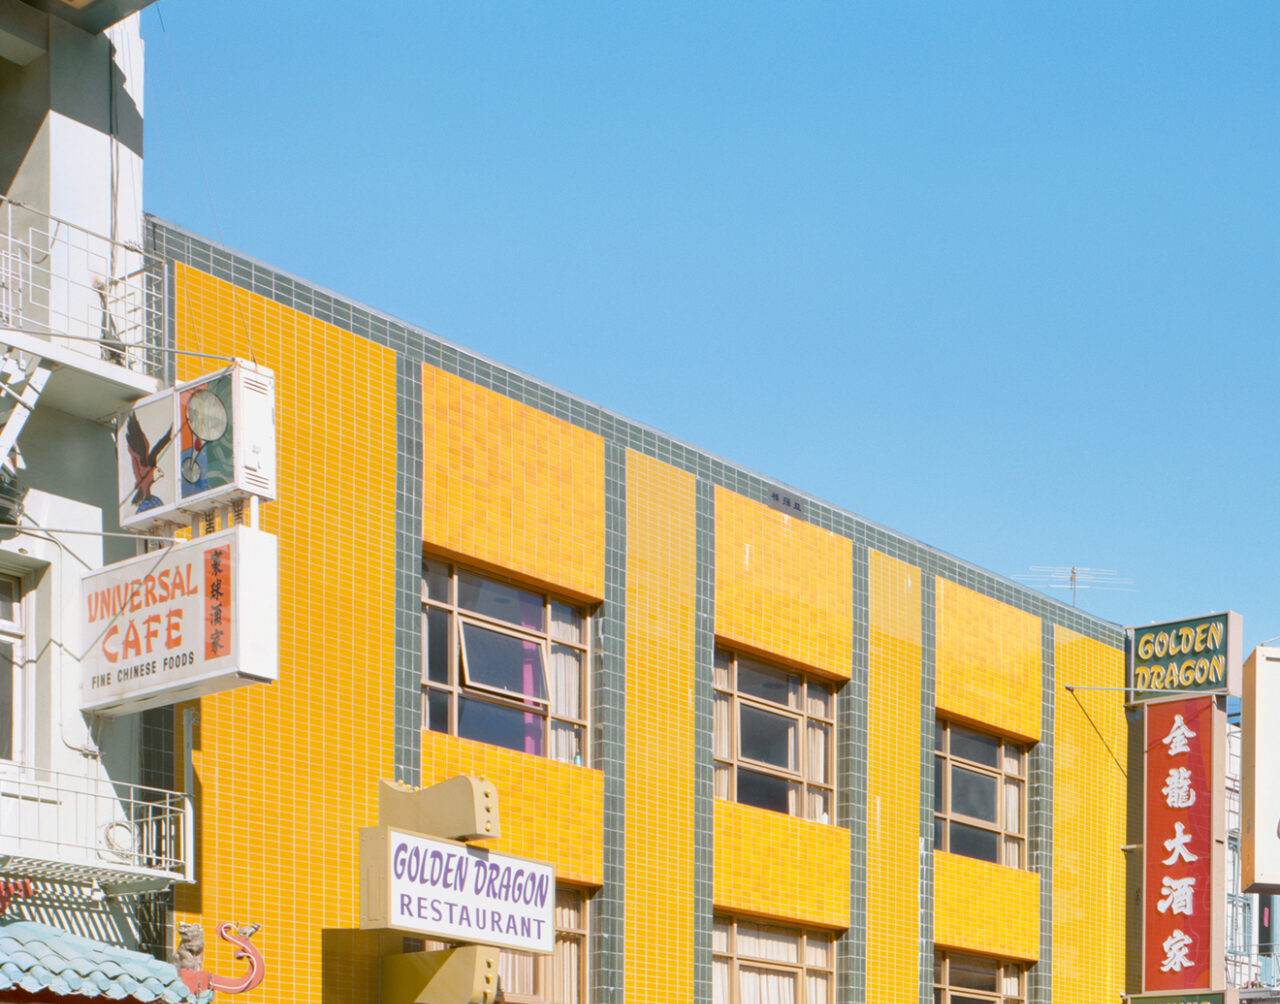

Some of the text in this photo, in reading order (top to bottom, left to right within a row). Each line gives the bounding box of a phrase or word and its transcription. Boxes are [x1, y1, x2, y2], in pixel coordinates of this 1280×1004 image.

[88, 563, 198, 623] UNIVERSAL
[102, 608, 183, 663] CAFE
[1138, 622, 1223, 660] GOLDEN
[92, 651, 194, 688] FINE CHINESE FOODS
[1135, 655, 1225, 695] DRAGON
[1157, 714, 1199, 972] 金龍大酒家
[394, 843, 549, 908] GOLDEN DRAGON
[400, 893, 545, 940] RESTAURANT
